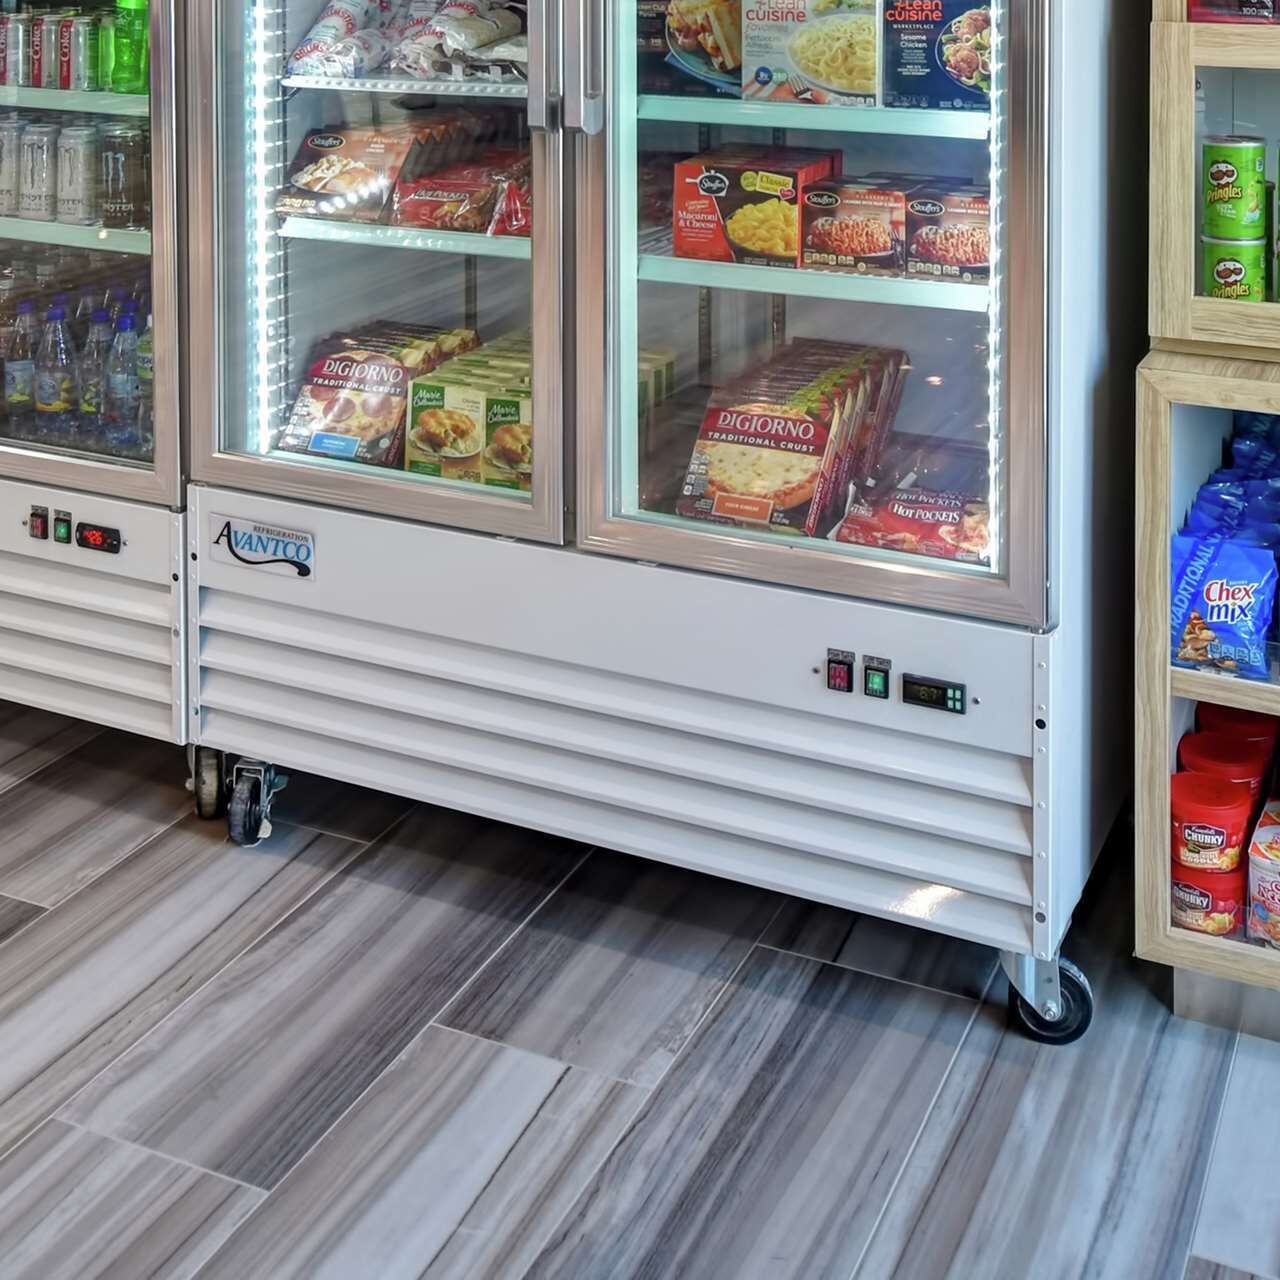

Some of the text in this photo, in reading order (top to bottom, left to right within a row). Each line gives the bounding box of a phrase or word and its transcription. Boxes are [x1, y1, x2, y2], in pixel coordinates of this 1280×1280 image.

[1242, 7, 1258, 16] 100
[32, 23, 42, 59] Coke
[60, 27, 70, 61] Coke
[899, 40, 929, 49] Chicken
[900, 33, 928, 42] Sesame
[759, 174, 792, 189] Classic
[1206, 184, 1243, 204] Pringles
[677, 210, 719, 224] Macaroni
[685, 218, 718, 230] Cheese
[321, 358, 404, 383] DIGIORNO
[312, 376, 402, 396] TRADITIONAL CRUST
[717, 410, 816, 440] DIGIORNO
[707, 430, 816, 454] TRADITIONAL CRUST
[917, 494, 962, 508] POCKETS
[892, 503, 961, 524] HOT POCKETS
[212, 520, 312, 566] AVANTCO
[252, 524, 310, 544] REFRIGERATION
[1171, 542, 1215, 639] TRADITIONAL
[1203, 579, 1259, 603] Chex
[1207, 599, 1254, 625] mix
[1184, 828, 1224, 846] CHUNKY
